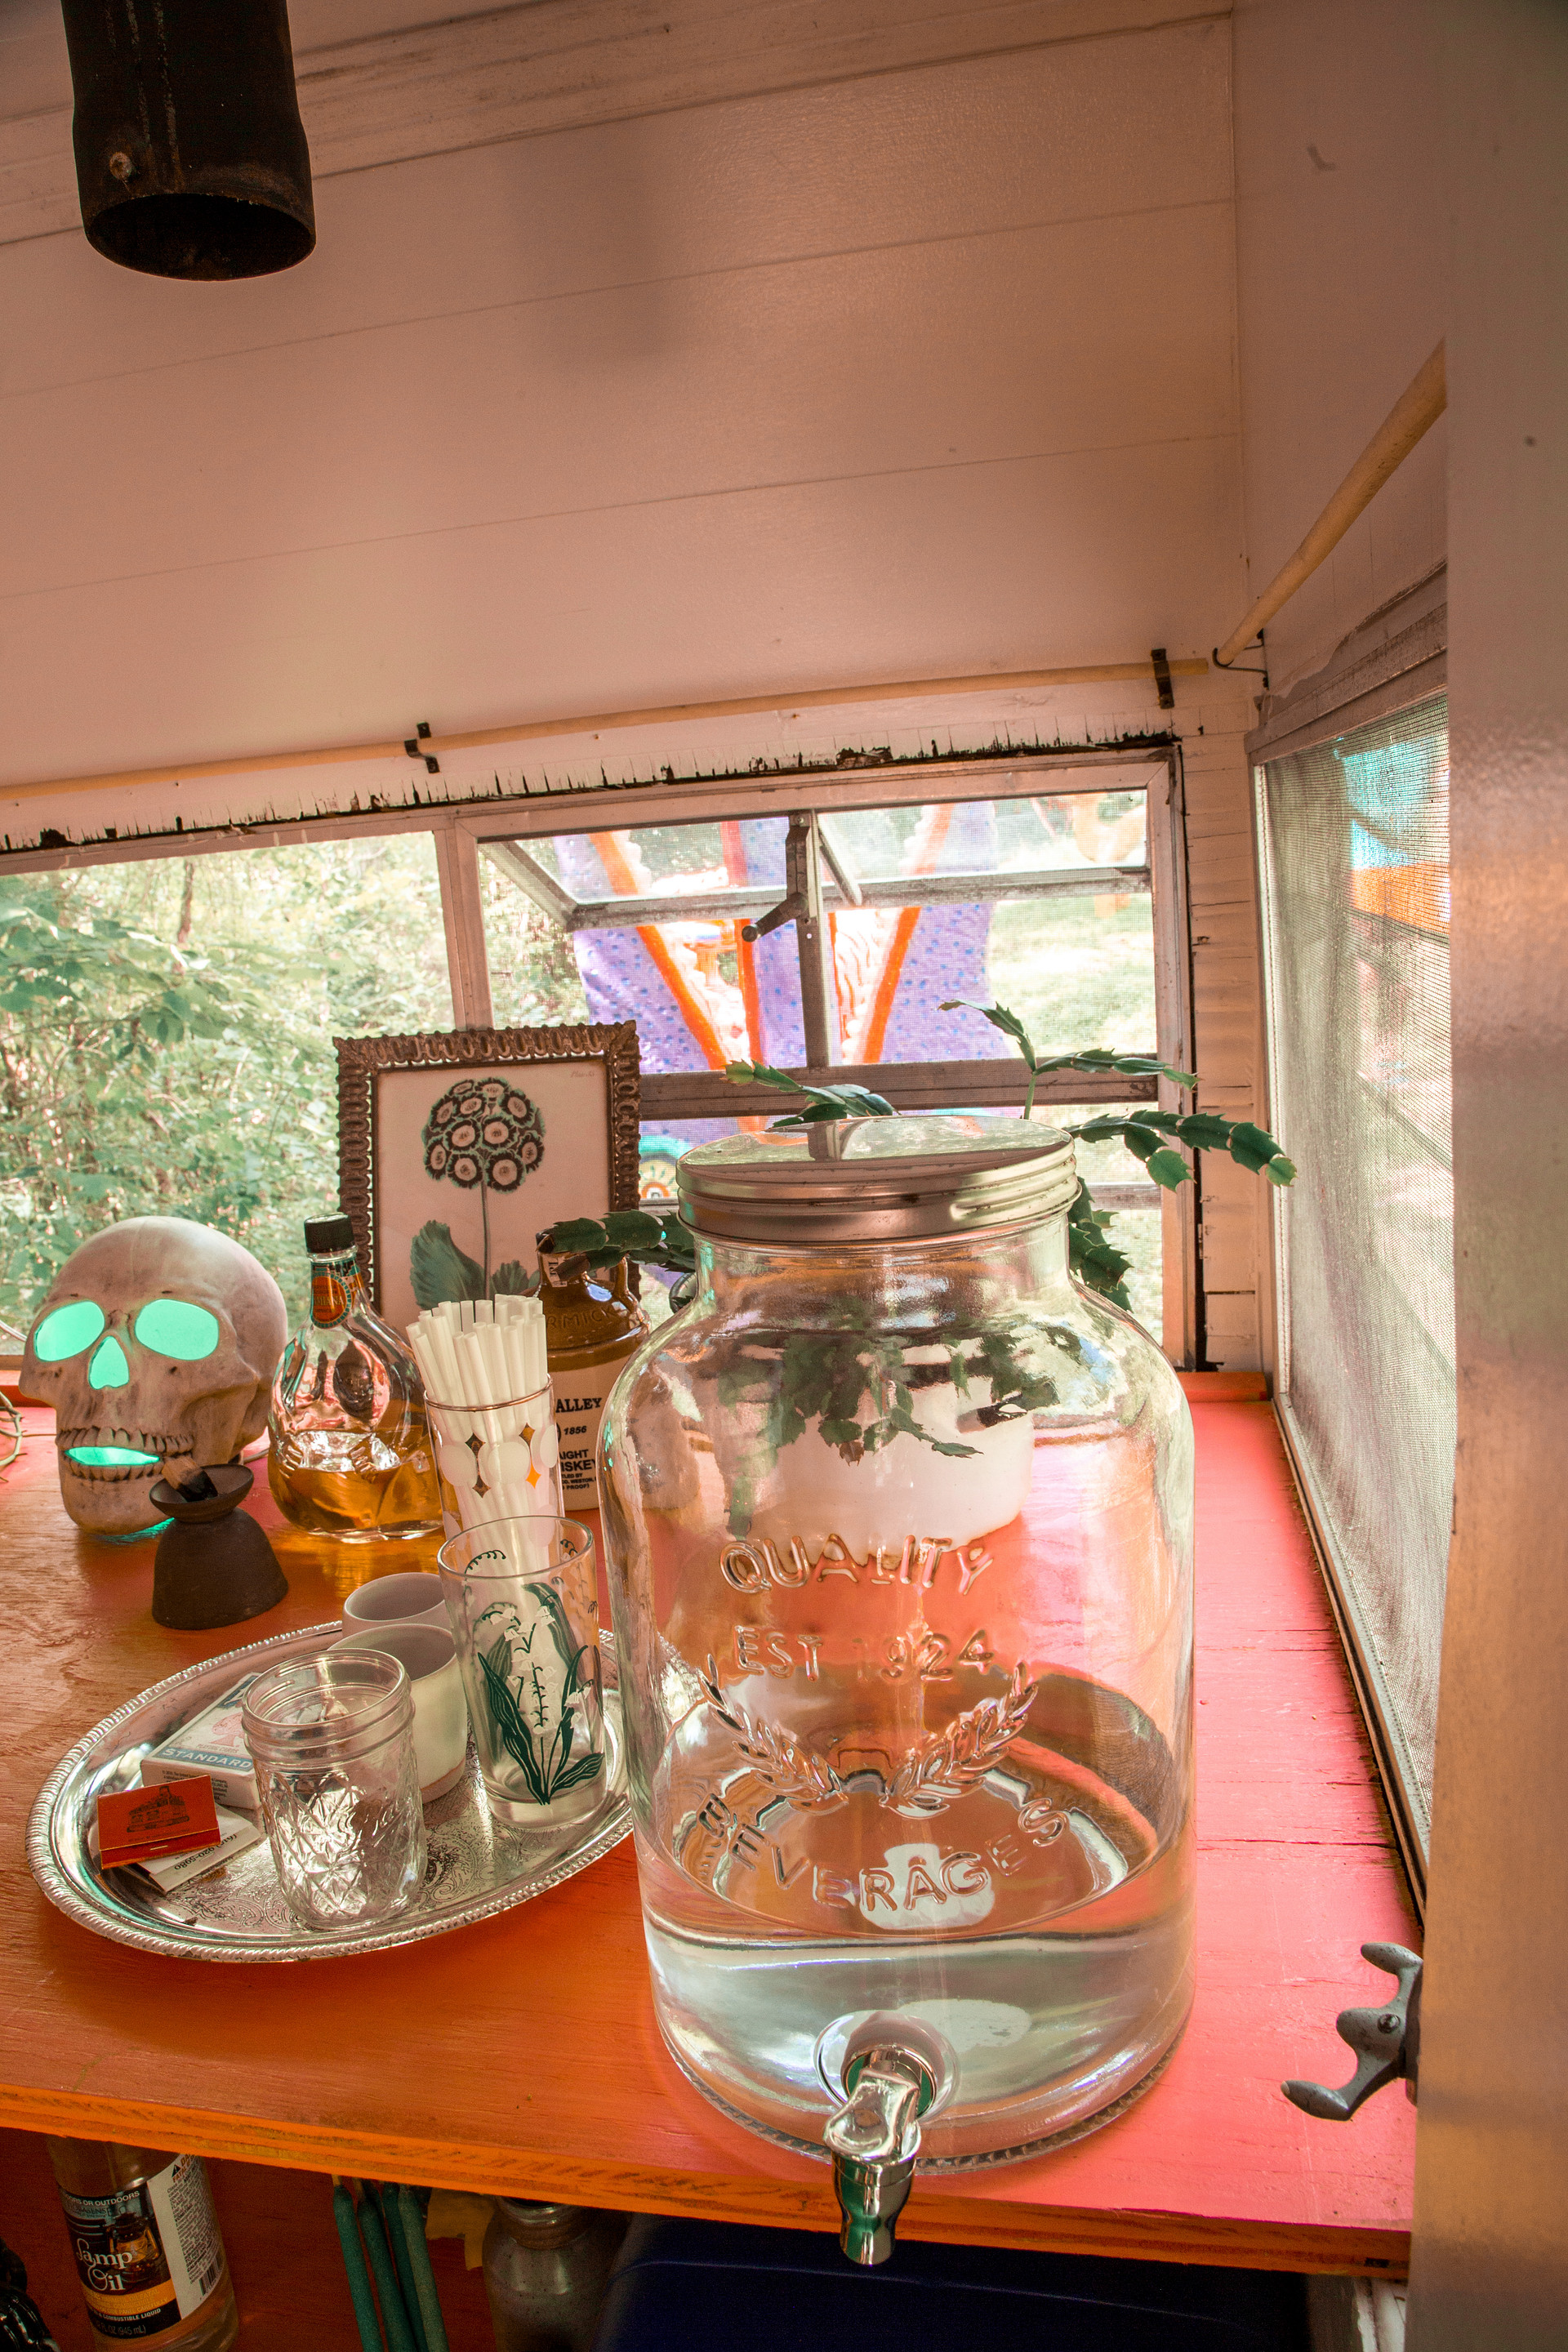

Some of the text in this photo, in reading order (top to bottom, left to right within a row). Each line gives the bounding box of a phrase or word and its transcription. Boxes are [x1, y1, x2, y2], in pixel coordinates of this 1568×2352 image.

[547, 1307, 614, 1329] RMICK
[555, 1397, 602, 1413] ALLEY
[564, 1426, 587, 1435] 1856
[719, 1533, 994, 1595] QUALITY
[734, 1624, 995, 1682] EST 1924
[163, 1748, 252, 1769] STANDARD
[174, 1847, 215, 1870] 920-5980
[697, 1793, 1067, 1913] BEVERAGES
[95, 2190, 140, 2206] OUTDOORS
[87, 2267, 127, 2291] Oil
[103, 2314, 140, 2322] COMBUSTIBLE
[141, 2308, 162, 2319] LIQUID
